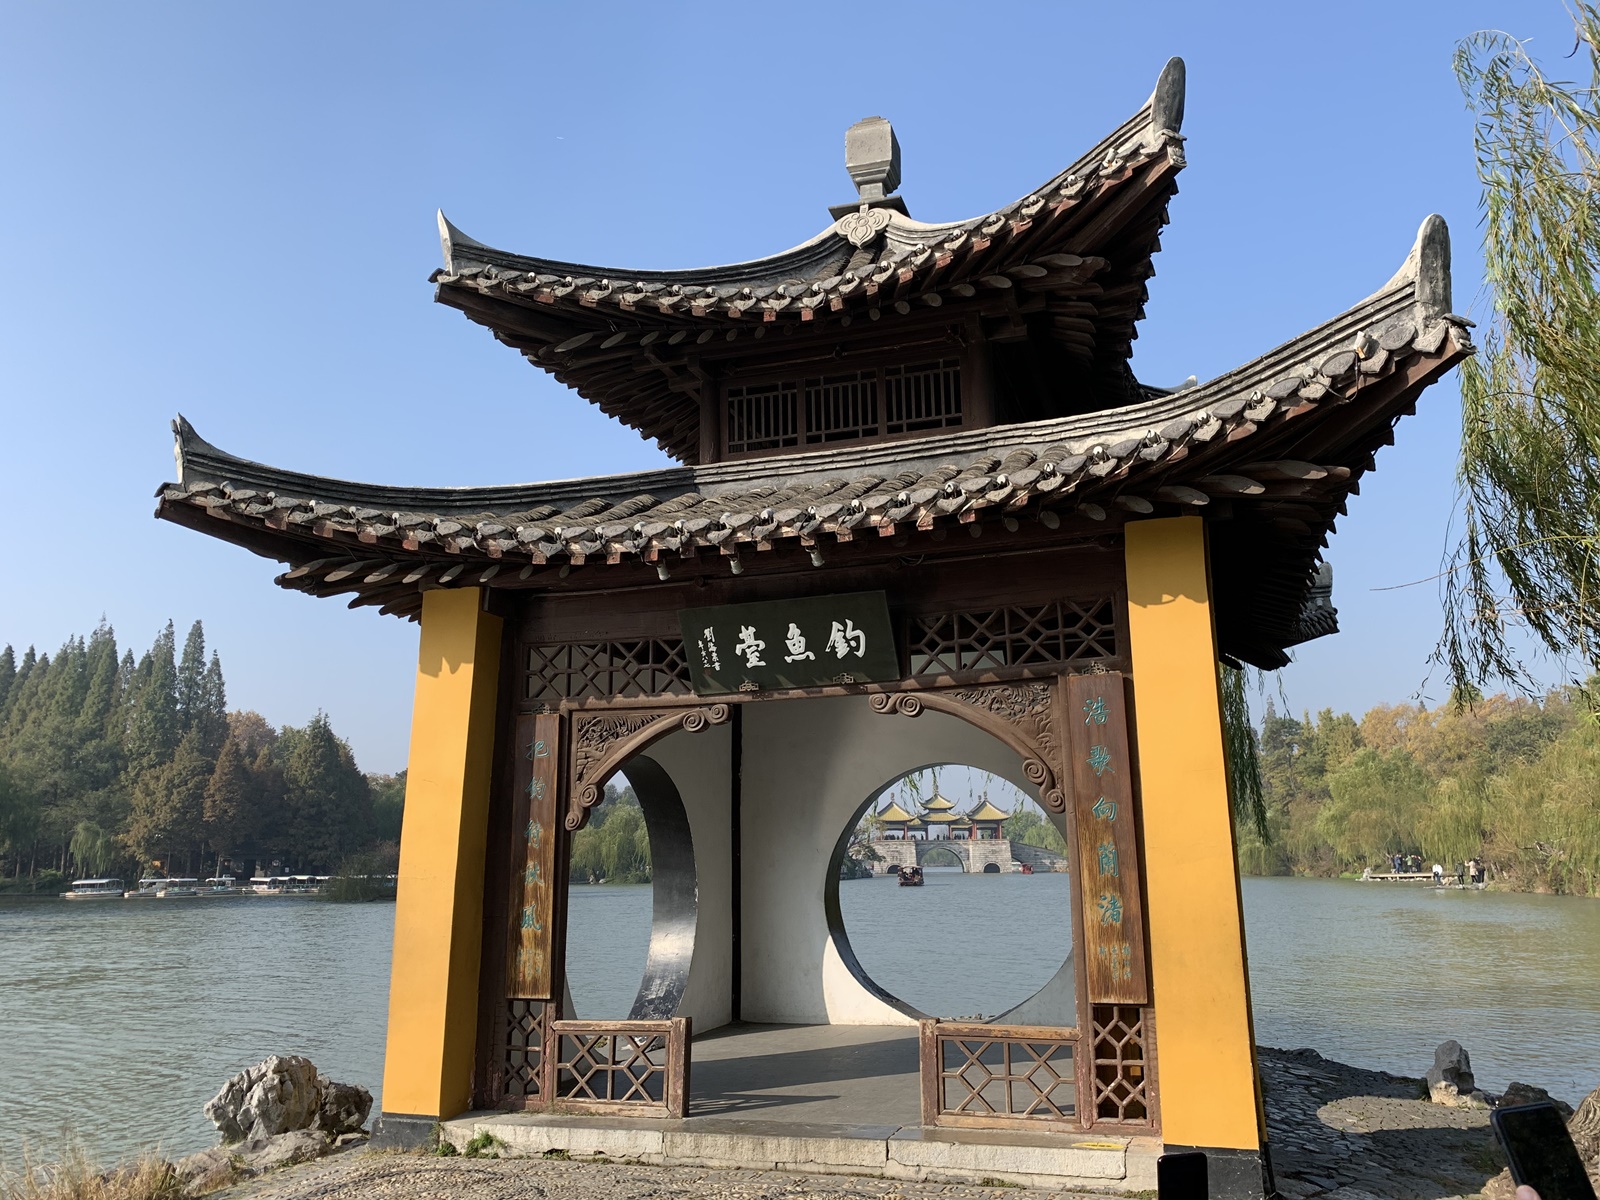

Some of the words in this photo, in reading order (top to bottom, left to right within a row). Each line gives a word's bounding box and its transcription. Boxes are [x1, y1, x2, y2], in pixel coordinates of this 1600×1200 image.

[1082, 697, 1124, 926] 浩歌向蘭渚
